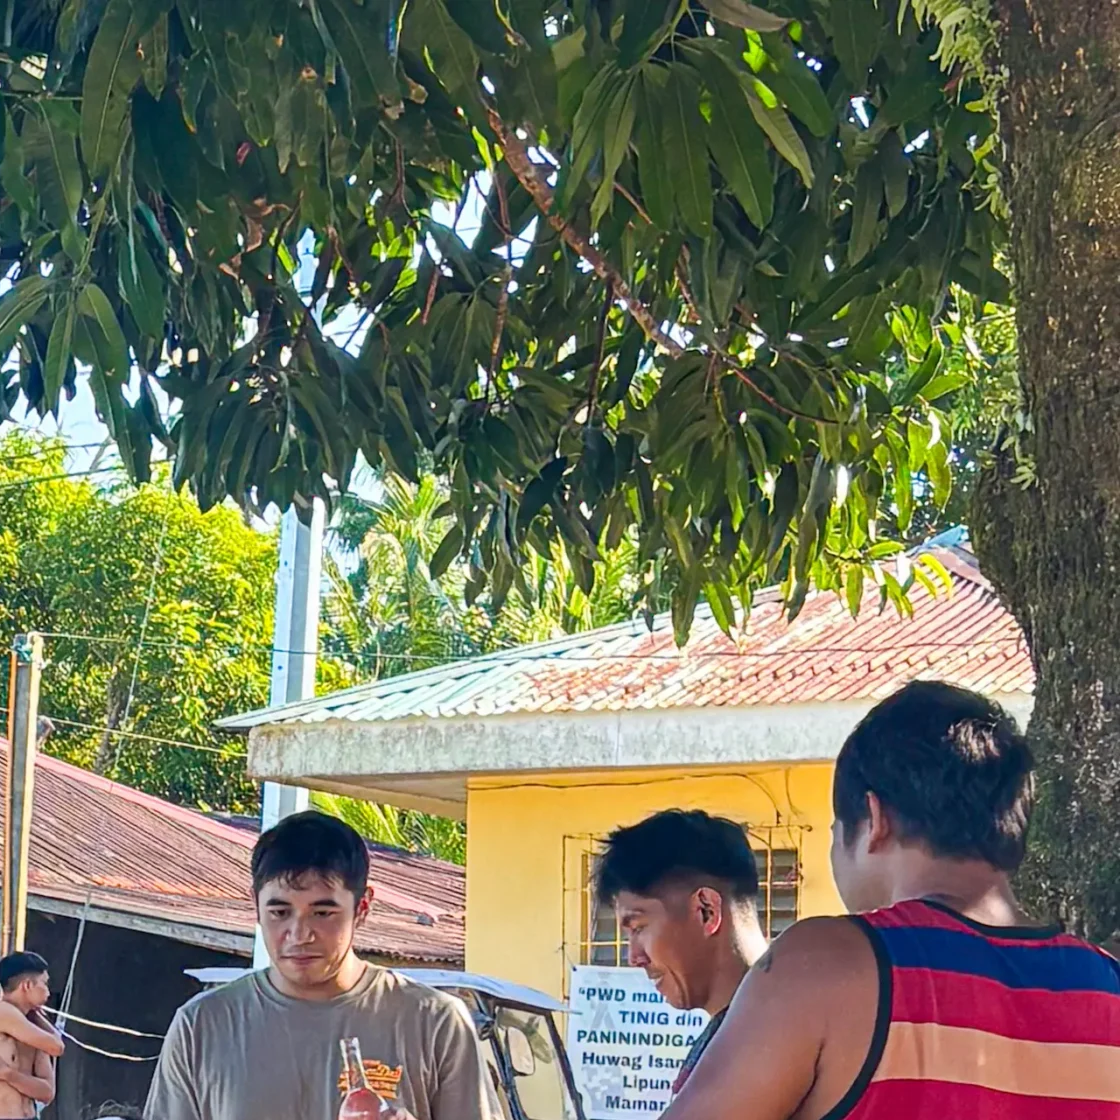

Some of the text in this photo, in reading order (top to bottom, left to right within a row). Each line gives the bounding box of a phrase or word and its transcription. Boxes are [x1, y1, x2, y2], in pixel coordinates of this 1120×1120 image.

[619, 1010, 703, 1027] TINIG din
[581, 1051, 643, 1071] Huwag
[622, 1075, 671, 1093] Lipun
